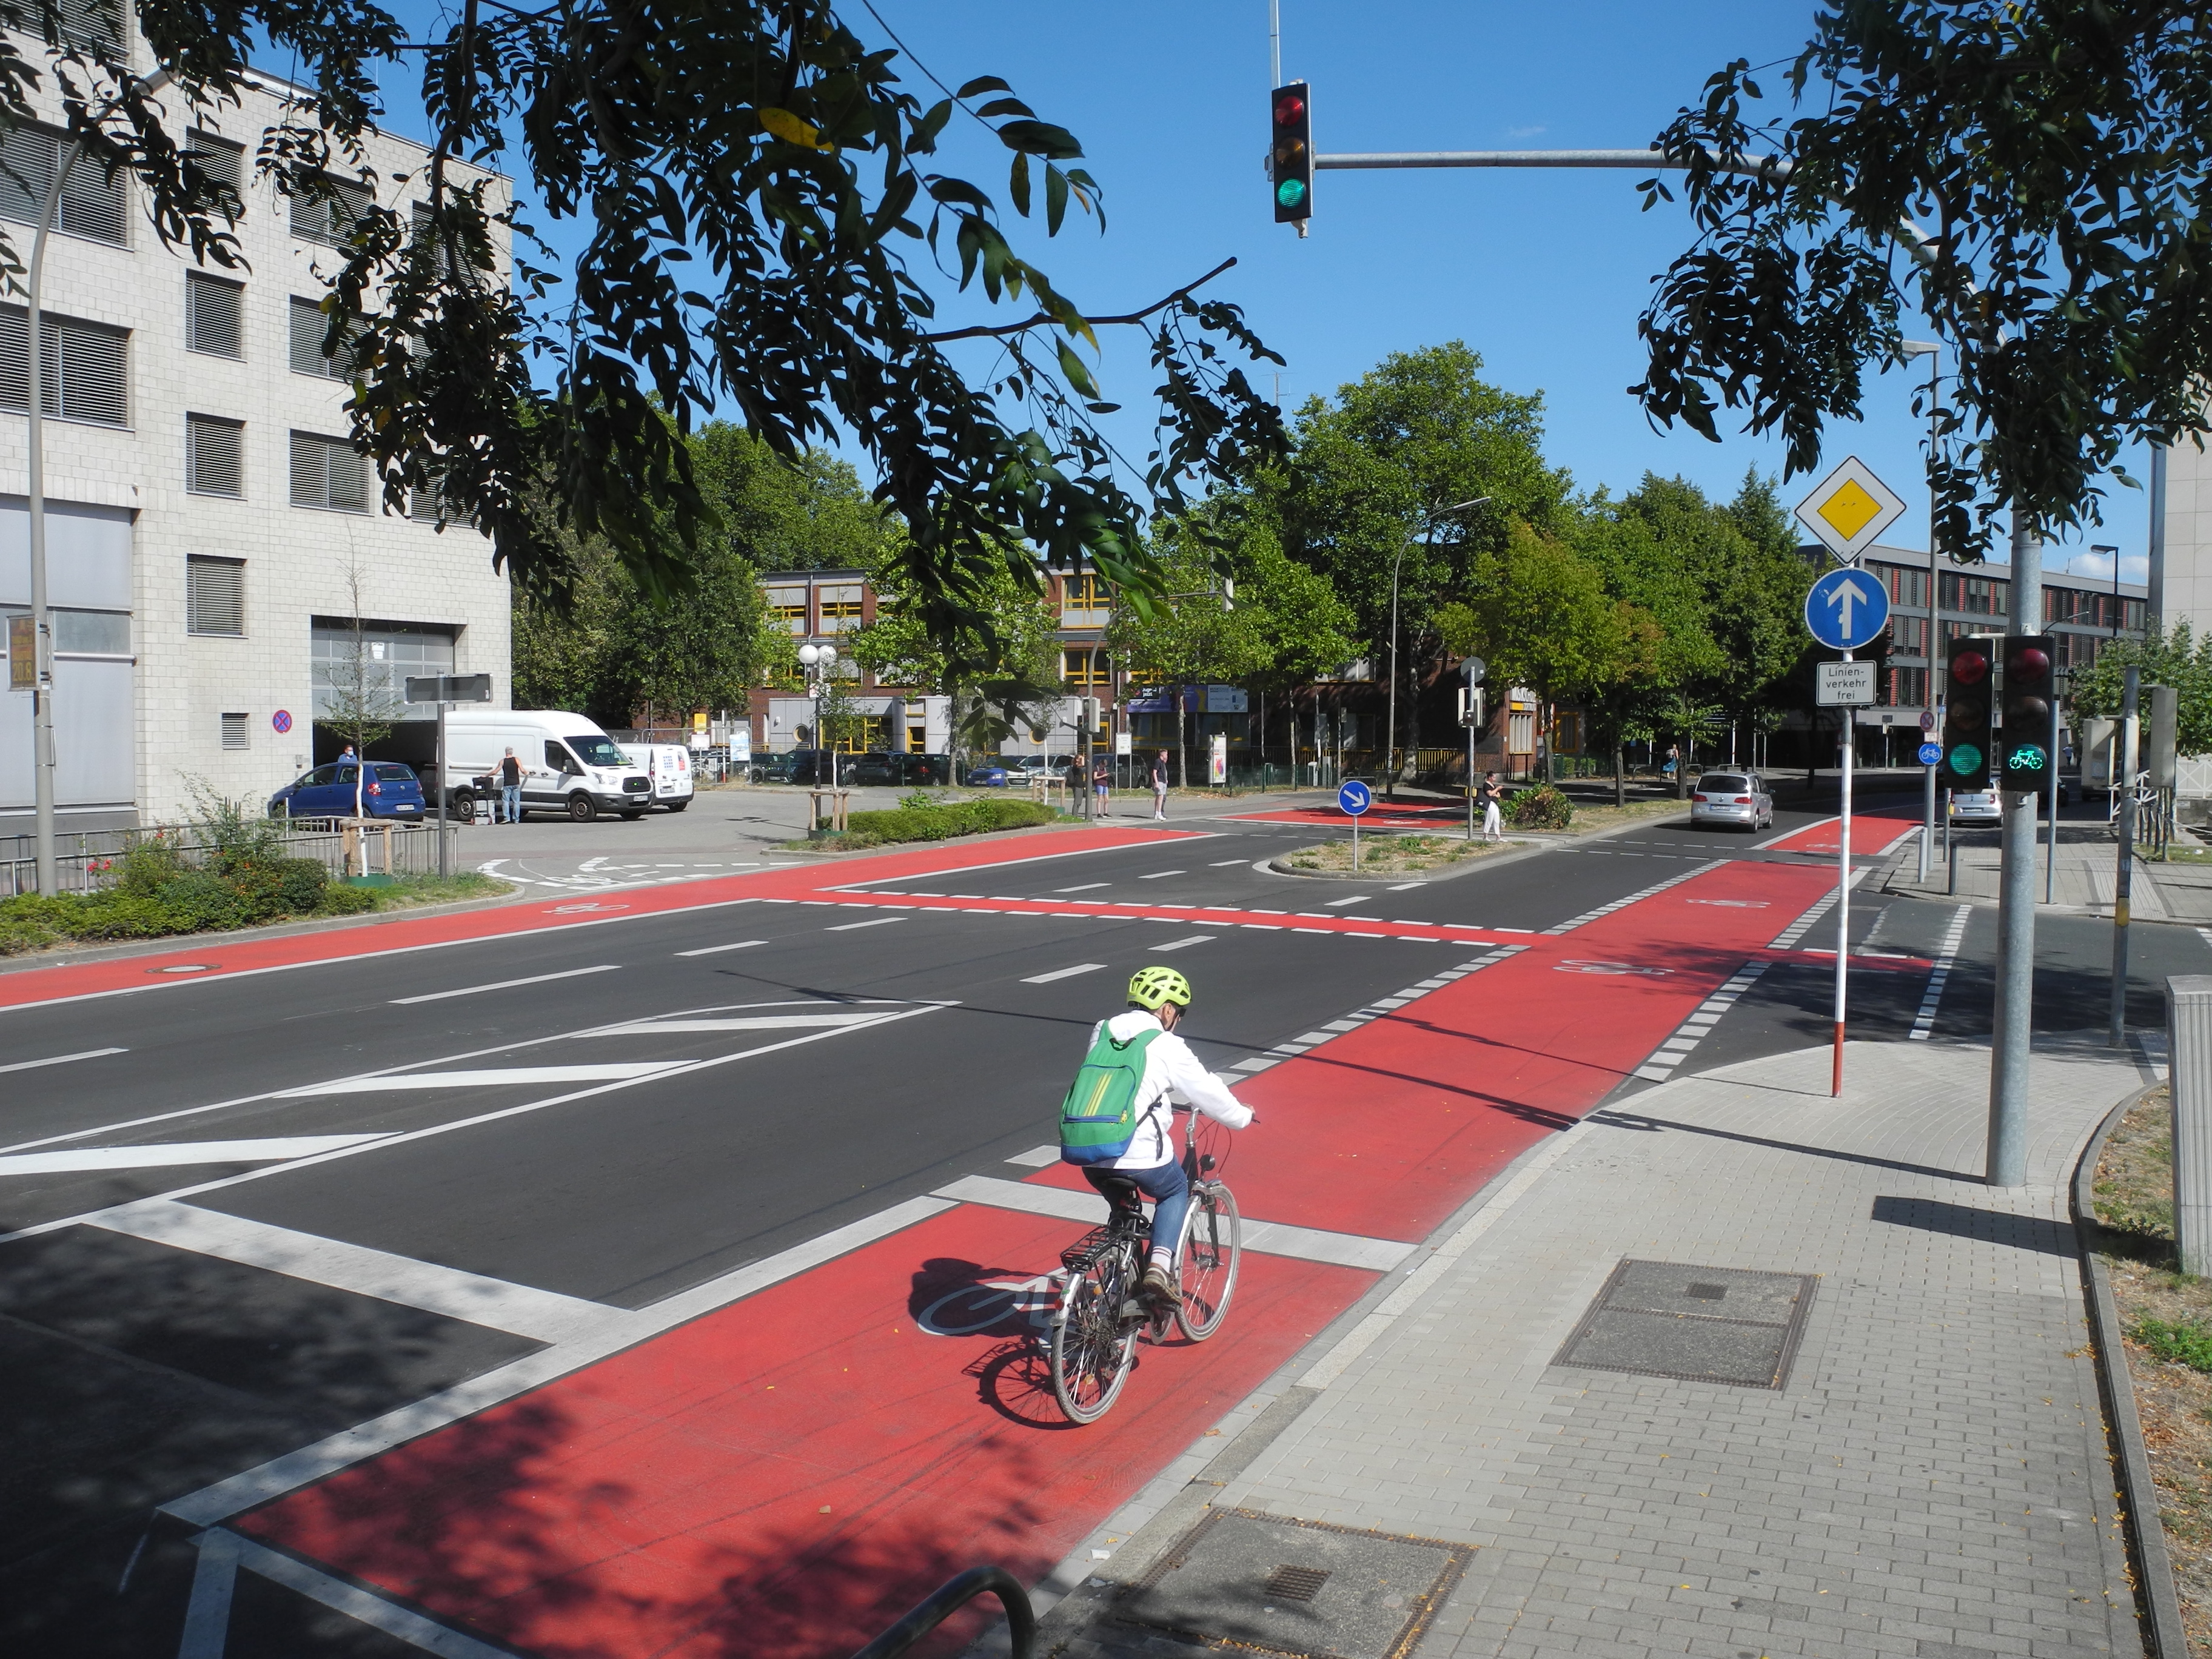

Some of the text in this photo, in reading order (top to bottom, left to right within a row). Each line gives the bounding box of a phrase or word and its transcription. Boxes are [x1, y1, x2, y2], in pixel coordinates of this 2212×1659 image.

[1829, 668, 1864, 677] Linien-
[1826, 679, 1866, 688] verkehr
[1837, 690, 1855, 700] frei
